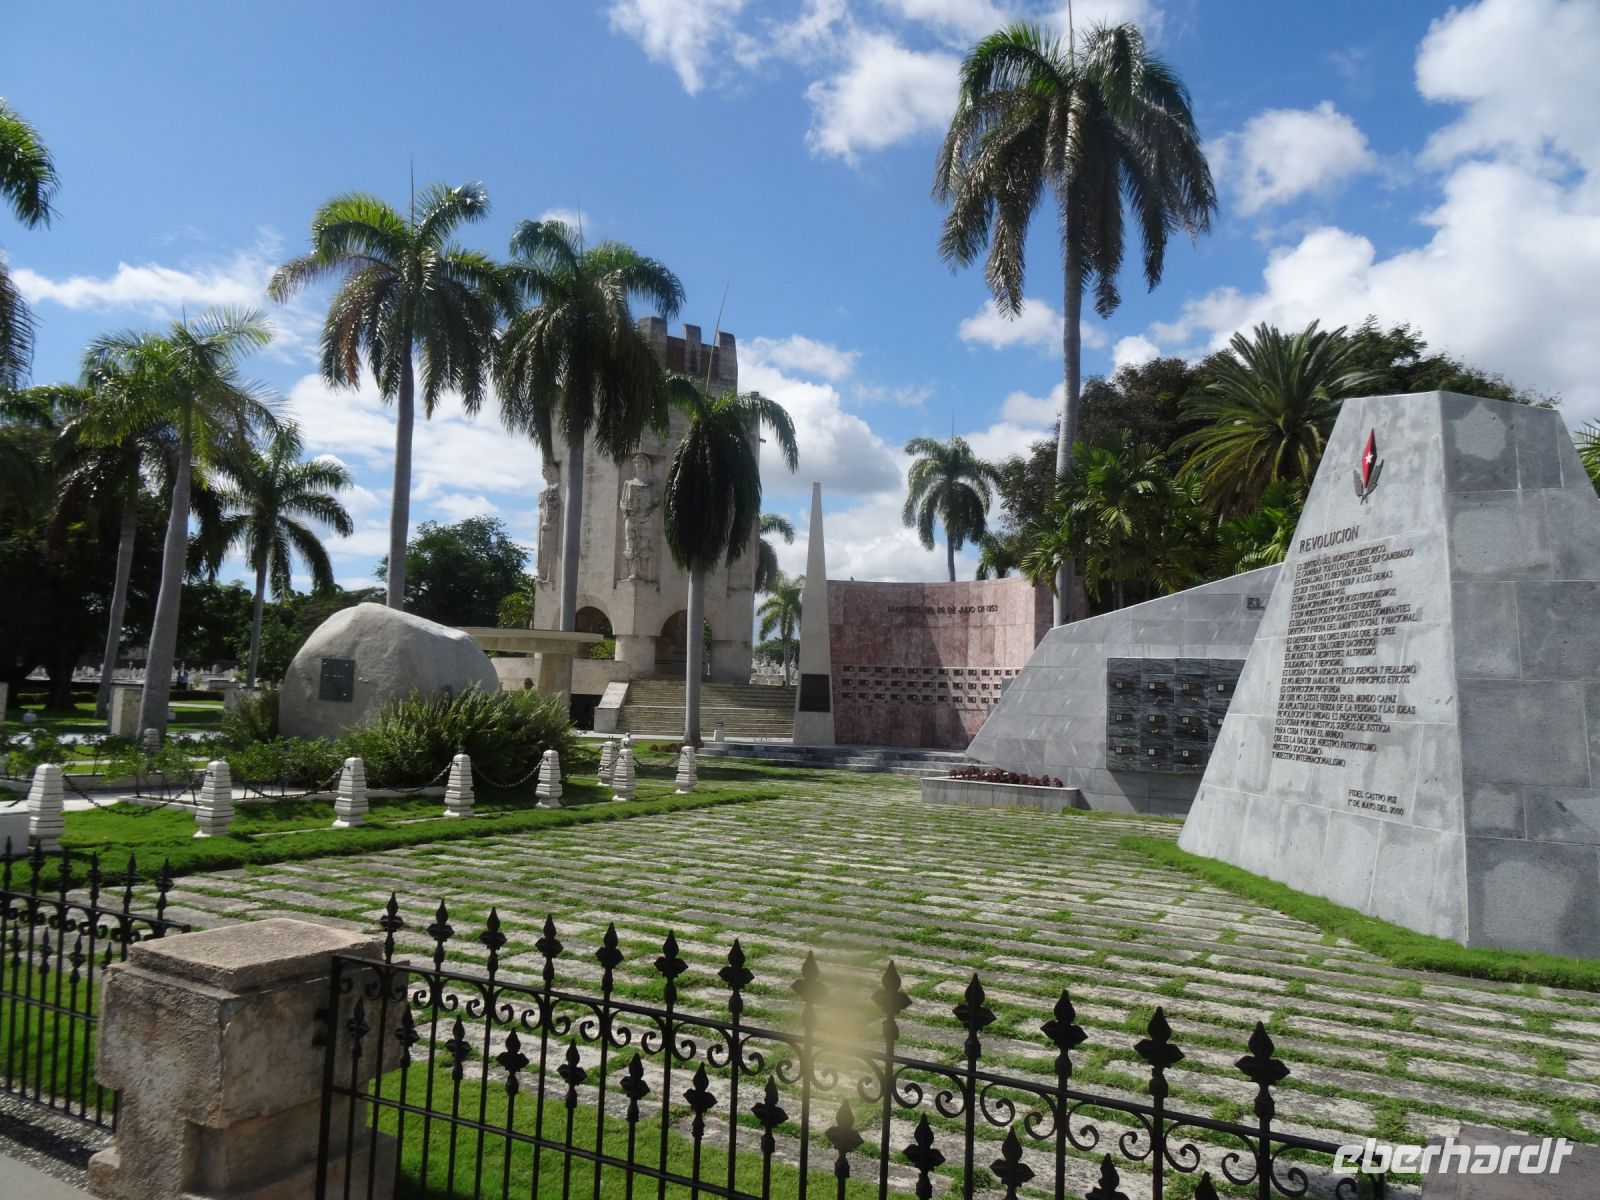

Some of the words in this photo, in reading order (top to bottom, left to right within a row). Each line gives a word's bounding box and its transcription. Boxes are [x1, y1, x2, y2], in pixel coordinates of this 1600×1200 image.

[1298, 526, 1360, 553] REVOLUCION
[1309, 582, 1330, 592] TRATADO
[1335, 577, 1355, 588] TRATAR
[1359, 618, 1380, 628] SOCIAL
[1376, 695, 1397, 703] CAPAZ
[1353, 704, 1377, 713] VERDAD
[1348, 789, 1364, 798] FIDEL
[1365, 792, 1386, 802] CASTRO
